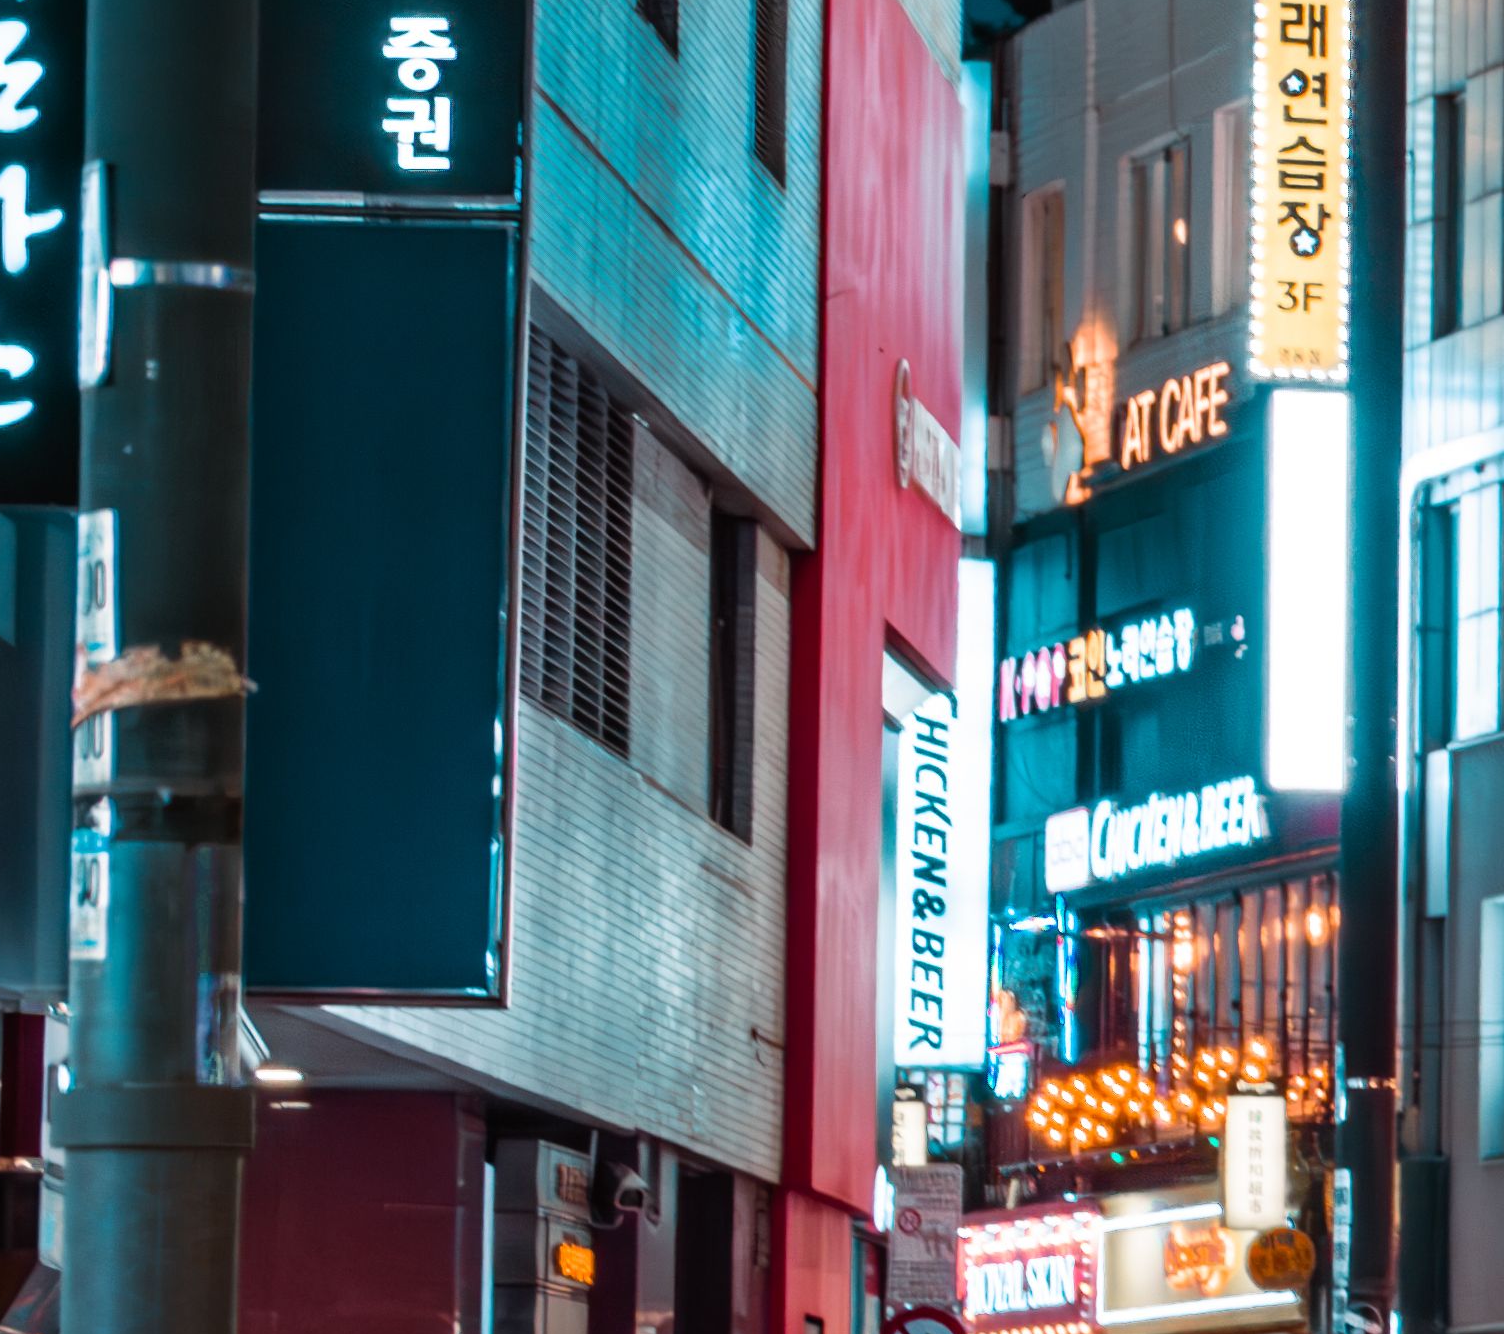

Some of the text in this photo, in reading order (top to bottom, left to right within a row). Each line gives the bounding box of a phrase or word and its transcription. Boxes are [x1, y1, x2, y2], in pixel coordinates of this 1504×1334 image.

[1277, 280, 1324, 312] 3F
[1121, 360, 1232, 469] AT CAFE
